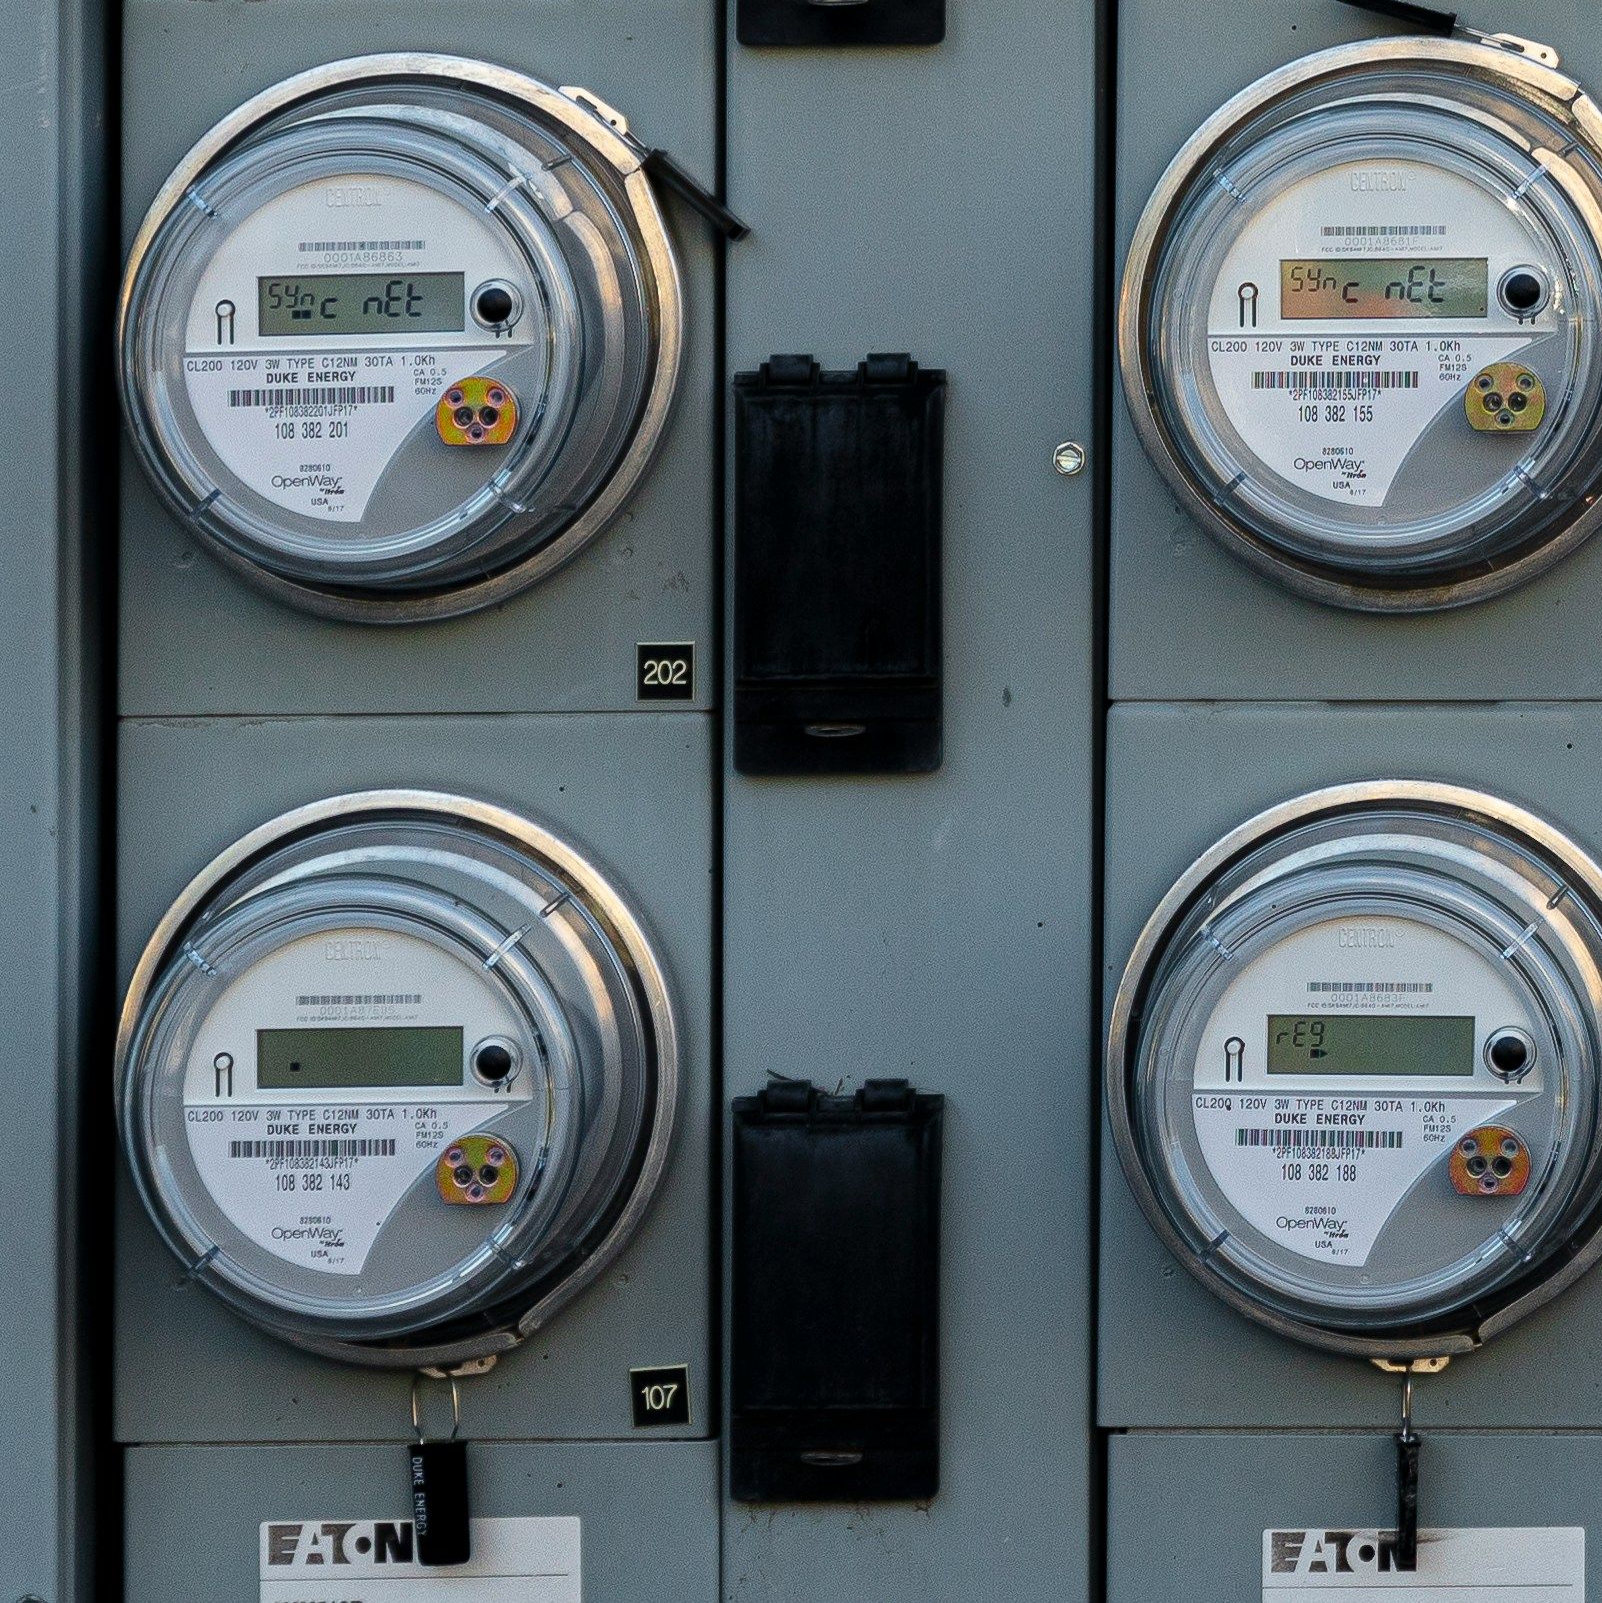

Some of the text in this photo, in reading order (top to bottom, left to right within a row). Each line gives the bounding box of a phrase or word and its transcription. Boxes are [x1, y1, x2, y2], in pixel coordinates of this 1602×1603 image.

[1291, 355, 1381, 366] DUKE ENERGY
[266, 370, 357, 384] DUKE ENERGY
[1298, 406, 1373, 422] 108 382 155
[275, 421, 350, 440] 108 382 201
[644, 660, 686, 684] 202
[1275, 1113, 1366, 1125] DUKE ENERGY
[267, 1123, 358, 1135] DUKE ENERGY
[1281, 1164, 1357, 1181] 108 382 188
[275, 1174, 351, 1191] 108 382 143
[642, 1385, 677, 1409] 107
[412, 1457, 427, 1536] DUKE ENERGY
[268, 1522, 413, 1566] EATON
